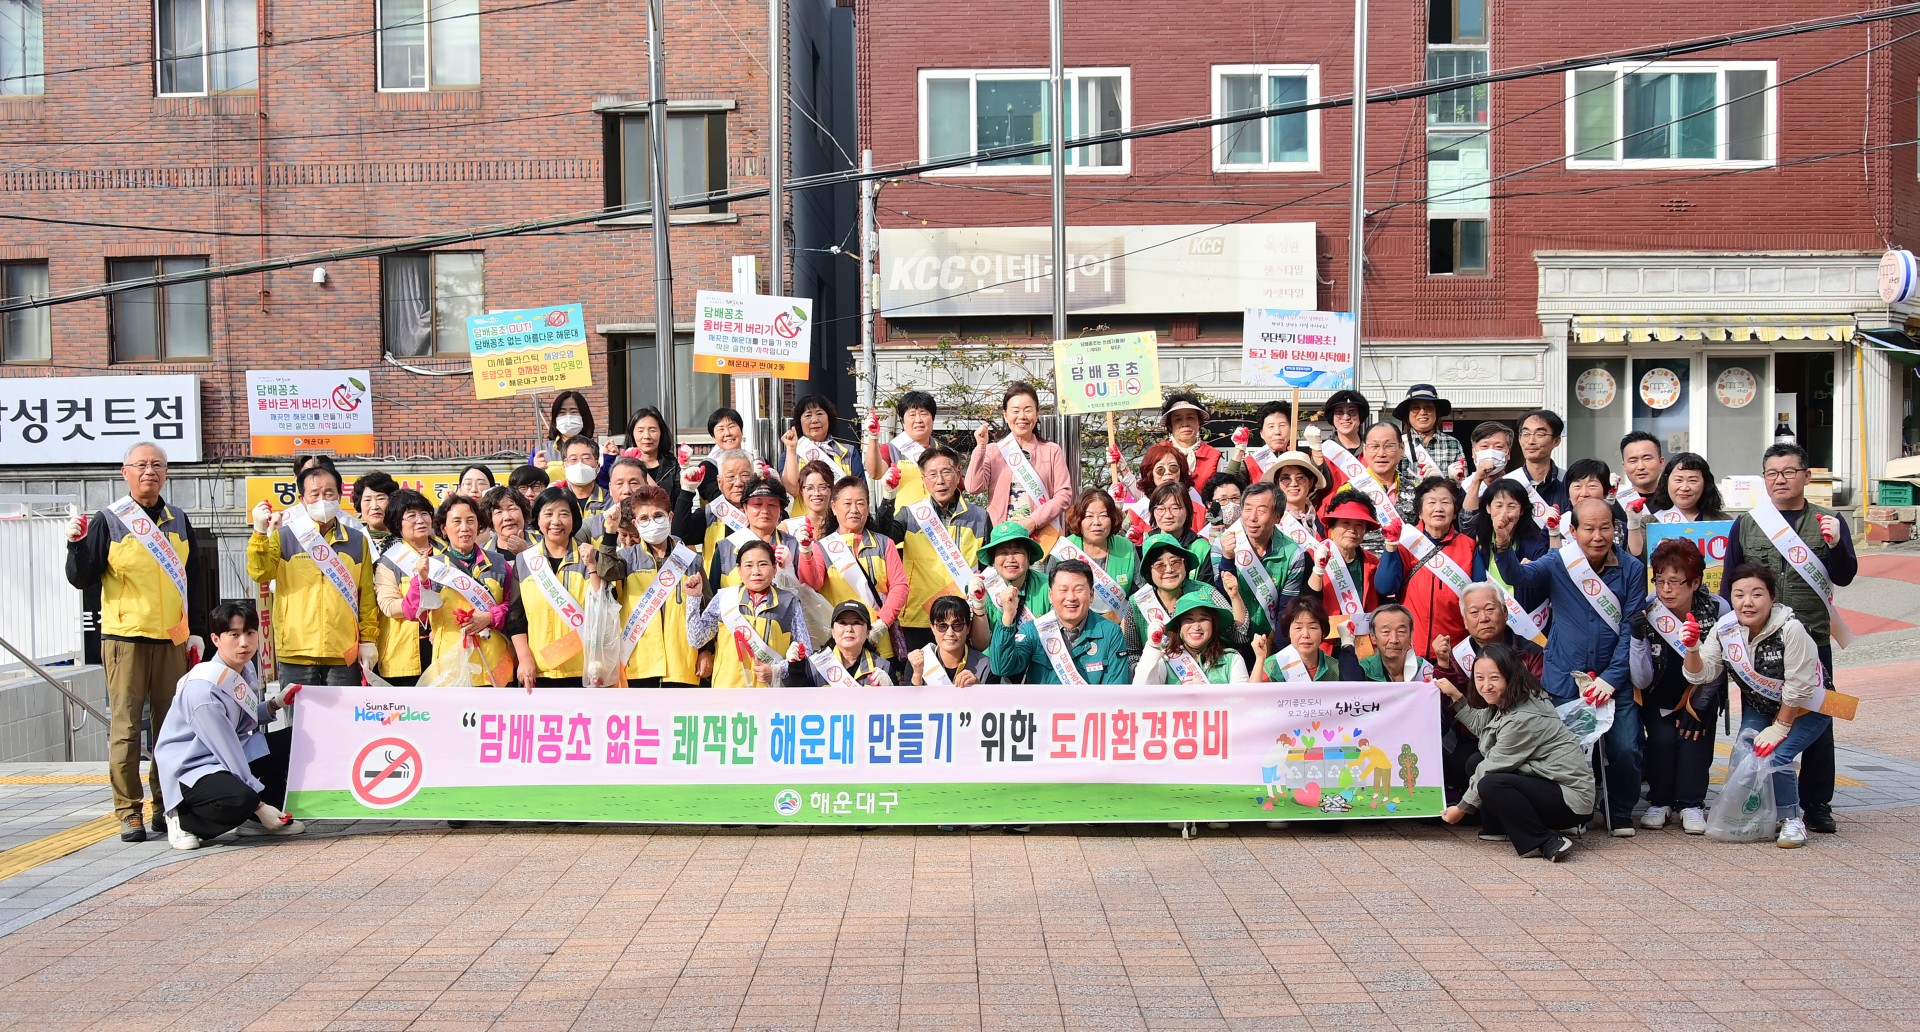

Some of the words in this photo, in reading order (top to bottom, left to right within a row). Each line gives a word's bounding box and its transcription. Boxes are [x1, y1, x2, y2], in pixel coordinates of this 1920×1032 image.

[1192, 237, 1222, 253] KCC
[704, 307, 743, 320] 담배꽁초
[473, 325, 507, 337] 담배꽁초
[508, 322, 533, 334] OUT!
[703, 320, 743, 333] 올바르게
[745, 323, 774, 336] 버리기
[475, 339, 505, 350] 담배꽁초
[506, 337, 521, 346] 없는
[524, 331, 554, 343] 아름다운
[556, 329, 579, 339] 해운대
[784, 340, 798, 348] 위한
[1261, 332, 1296, 344] 무단투기
[1297, 334, 1336, 346] 담배꽁초!
[487, 354, 539, 368] 미세플라스틱
[1249, 348, 1267, 358] 돌고
[1270, 349, 1288, 360] 돌아
[1291, 350, 1318, 361] 당신의
[727, 359, 757, 369] 해운대구
[1071, 362, 1139, 381] 담배꽁초
[256, 384, 299, 396] 담배꽁초
[508, 377, 538, 387] 해운대구
[1085, 379, 1123, 398] OUT!
[257, 398, 300, 411] 올바르게
[302, 398, 332, 410] 버리기
[0, 396, 184, 443] 성컷트점
[1016, 463, 1042, 498] 담배꽁초
[151, 531, 180, 567] 담배꽁초
[1246, 564, 1275, 605] 담배꽁초
[1440, 564, 1468, 591] 담배꽁
[537, 569, 567, 607] 담배꽁초
[561, 603, 584, 627] NO
[1339, 589, 1359, 615] NO
[1595, 592, 1625, 628] 담배꽁
[366, 702, 406, 711] Sun&Fun
[605, 714, 660, 765] 없는
[672, 711, 758, 765] 쾌적한
[770, 711, 855, 765] 해운대
[980, 709, 1037, 763] 위한
[1050, 708, 1228, 762] 도시환경정비
[810, 790, 899, 815] 해운대구
